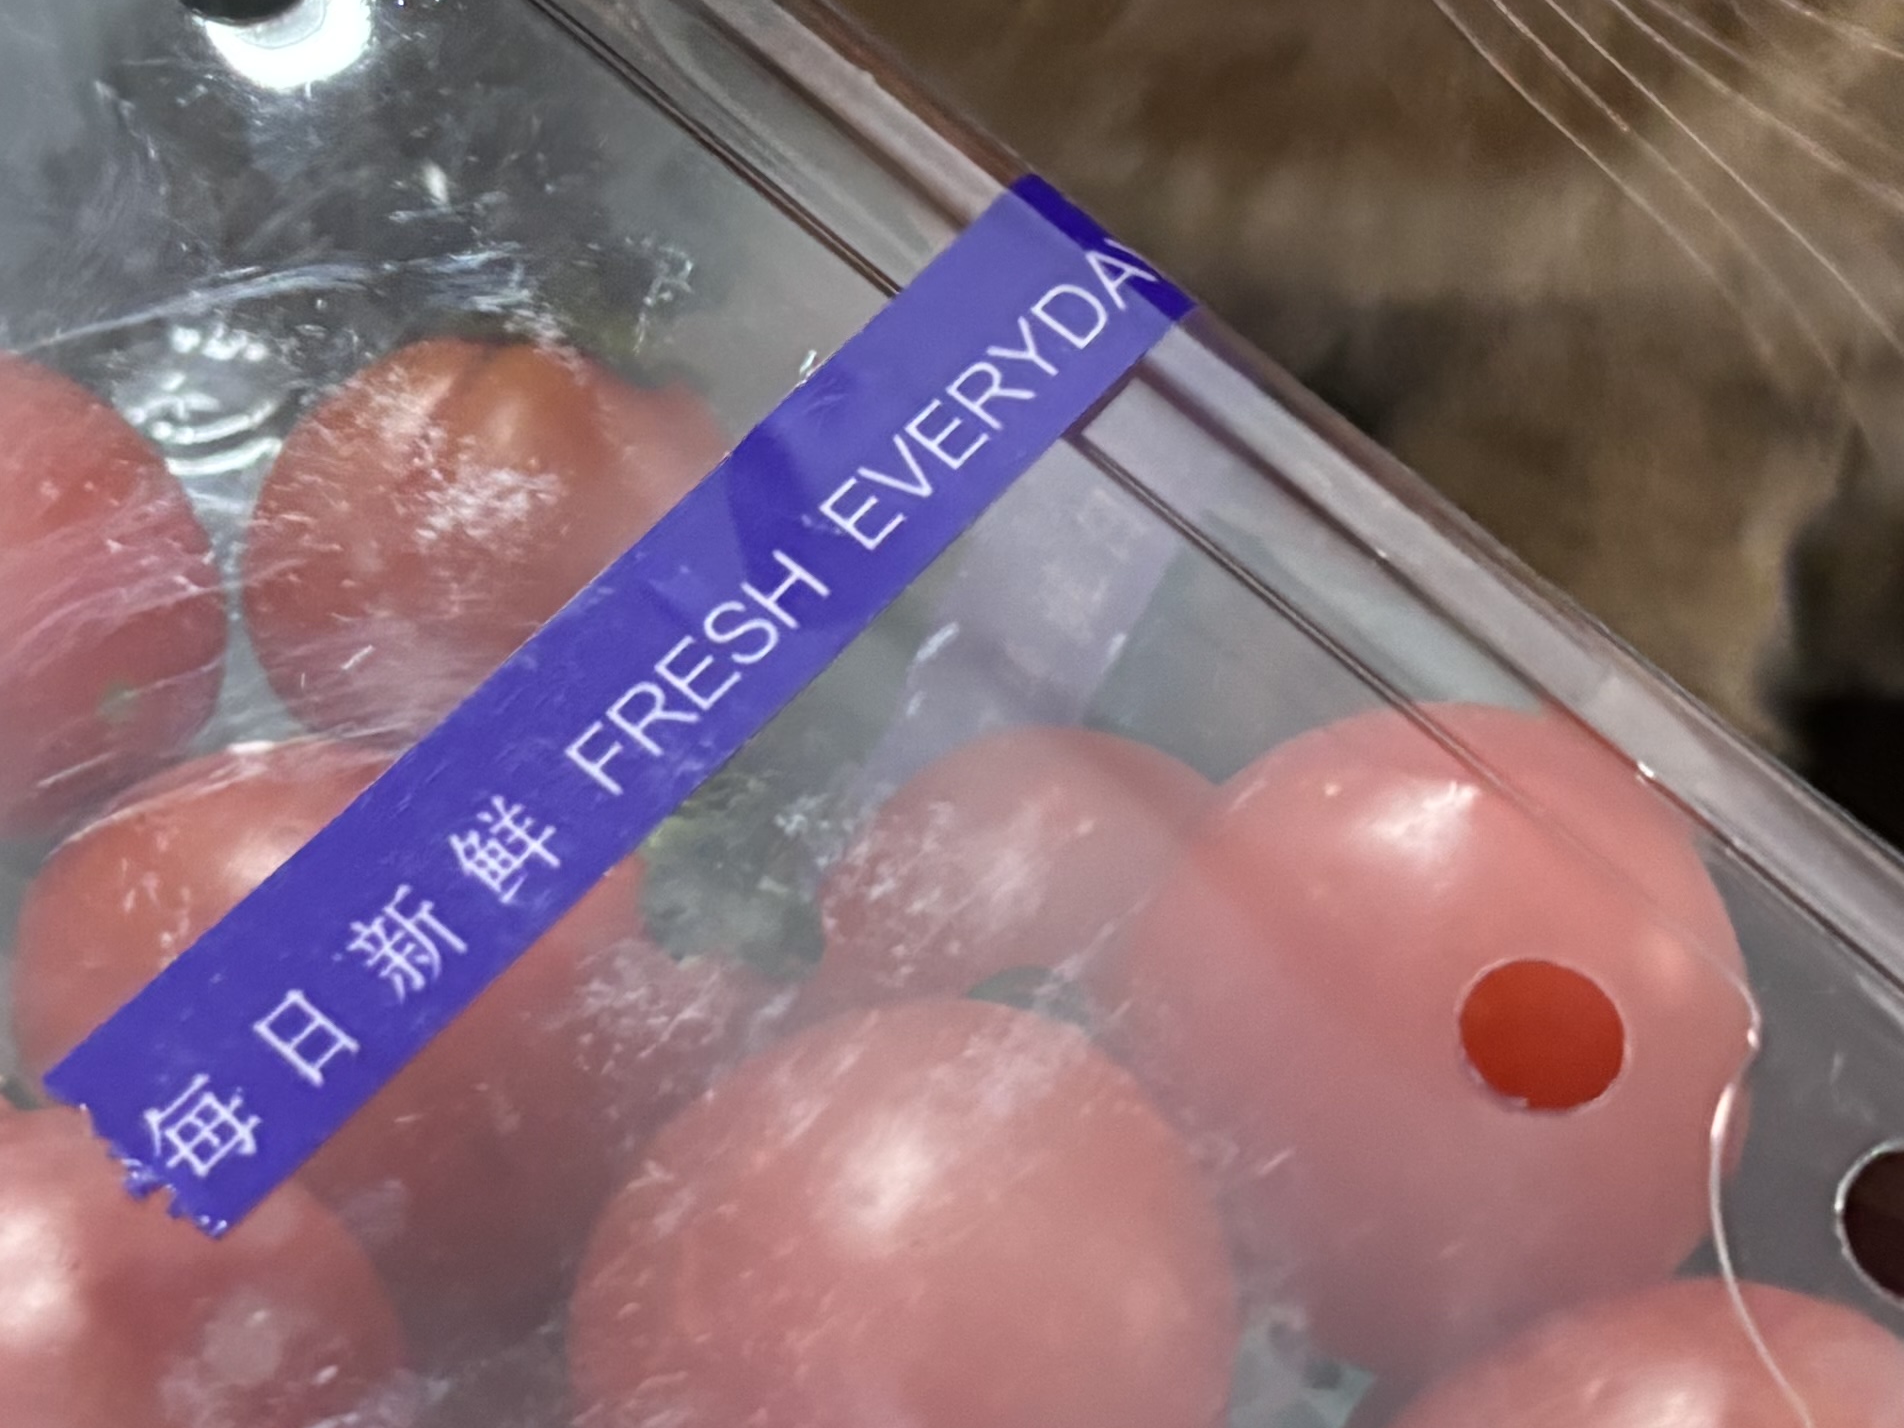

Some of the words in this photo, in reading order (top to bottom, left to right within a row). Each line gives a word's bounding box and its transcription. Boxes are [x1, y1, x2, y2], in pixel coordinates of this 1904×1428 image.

[143, 795, 561, 1176] 每日新鲜
[564, 549, 831, 797] FRESH
[818, 237, 1159, 551] EVERYDA
